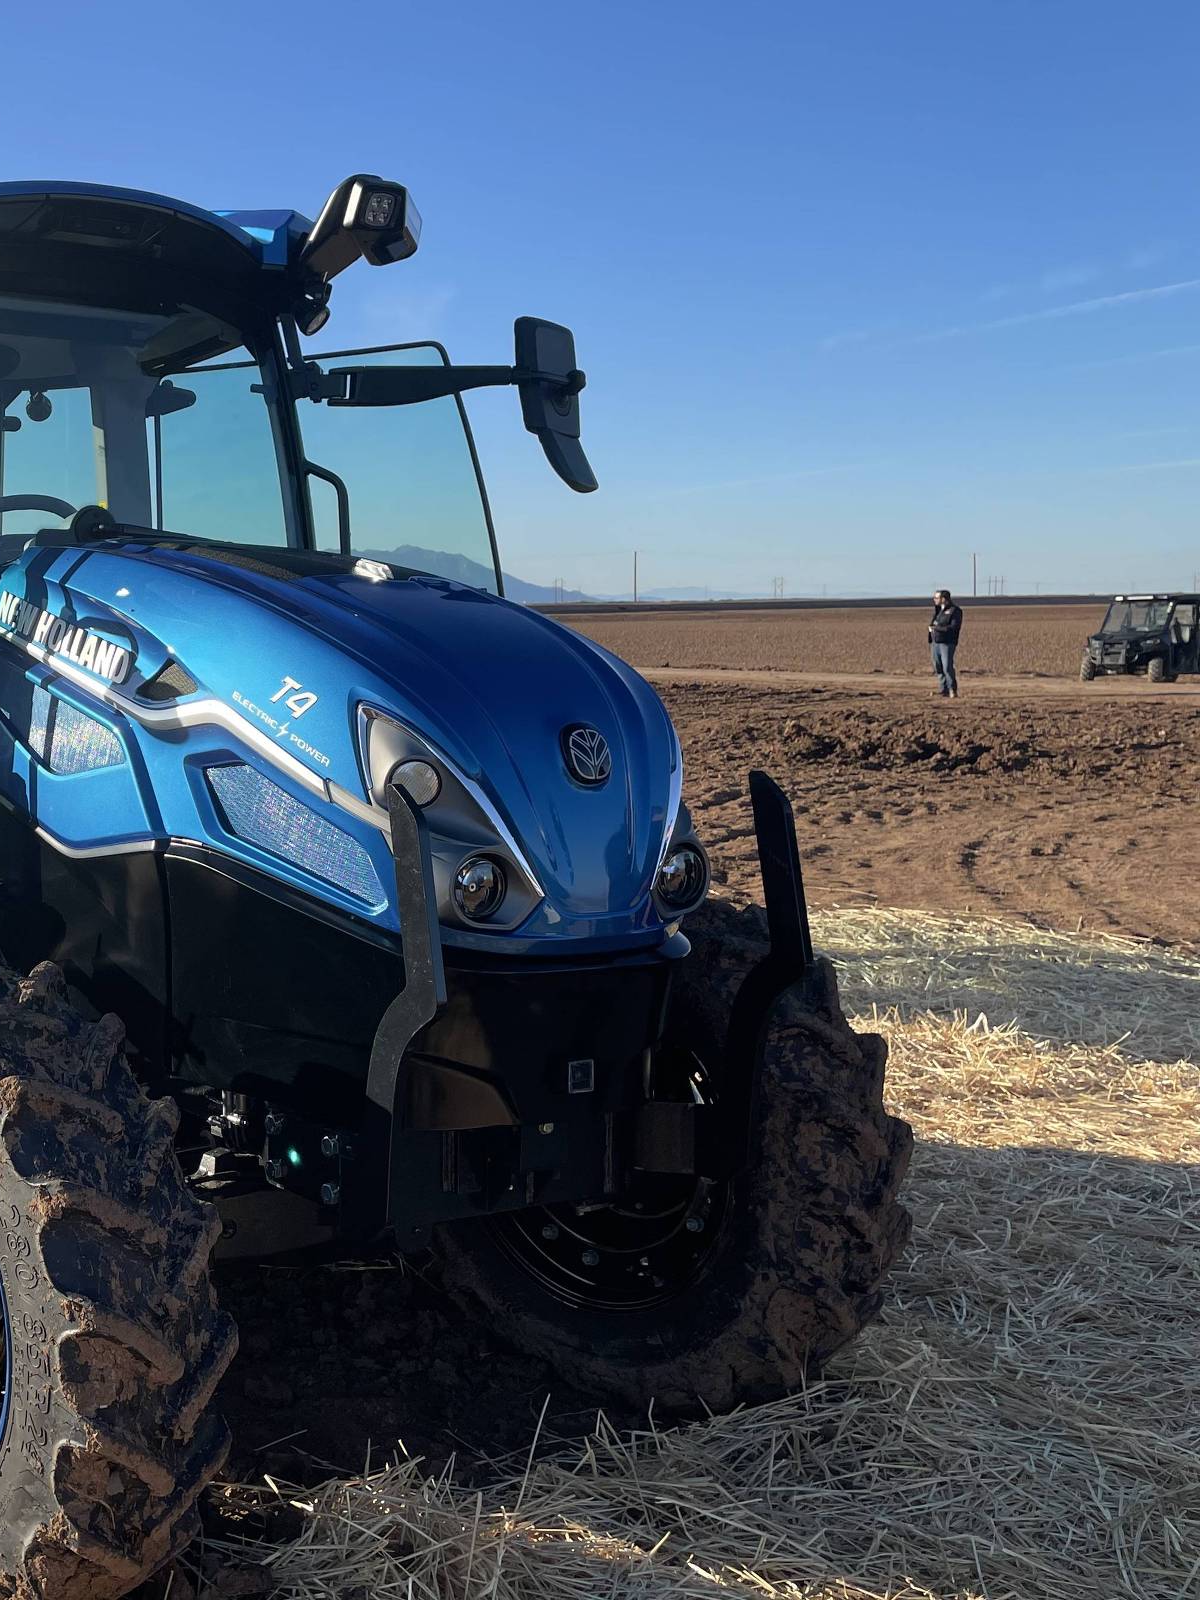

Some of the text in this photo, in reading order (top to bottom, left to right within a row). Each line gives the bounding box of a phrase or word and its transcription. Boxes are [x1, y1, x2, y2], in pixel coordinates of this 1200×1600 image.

[33, 610, 130, 684] HOLLAND
[232, 690, 331, 768] ELECTRIC POWER
[269, 675, 319, 719] T4
